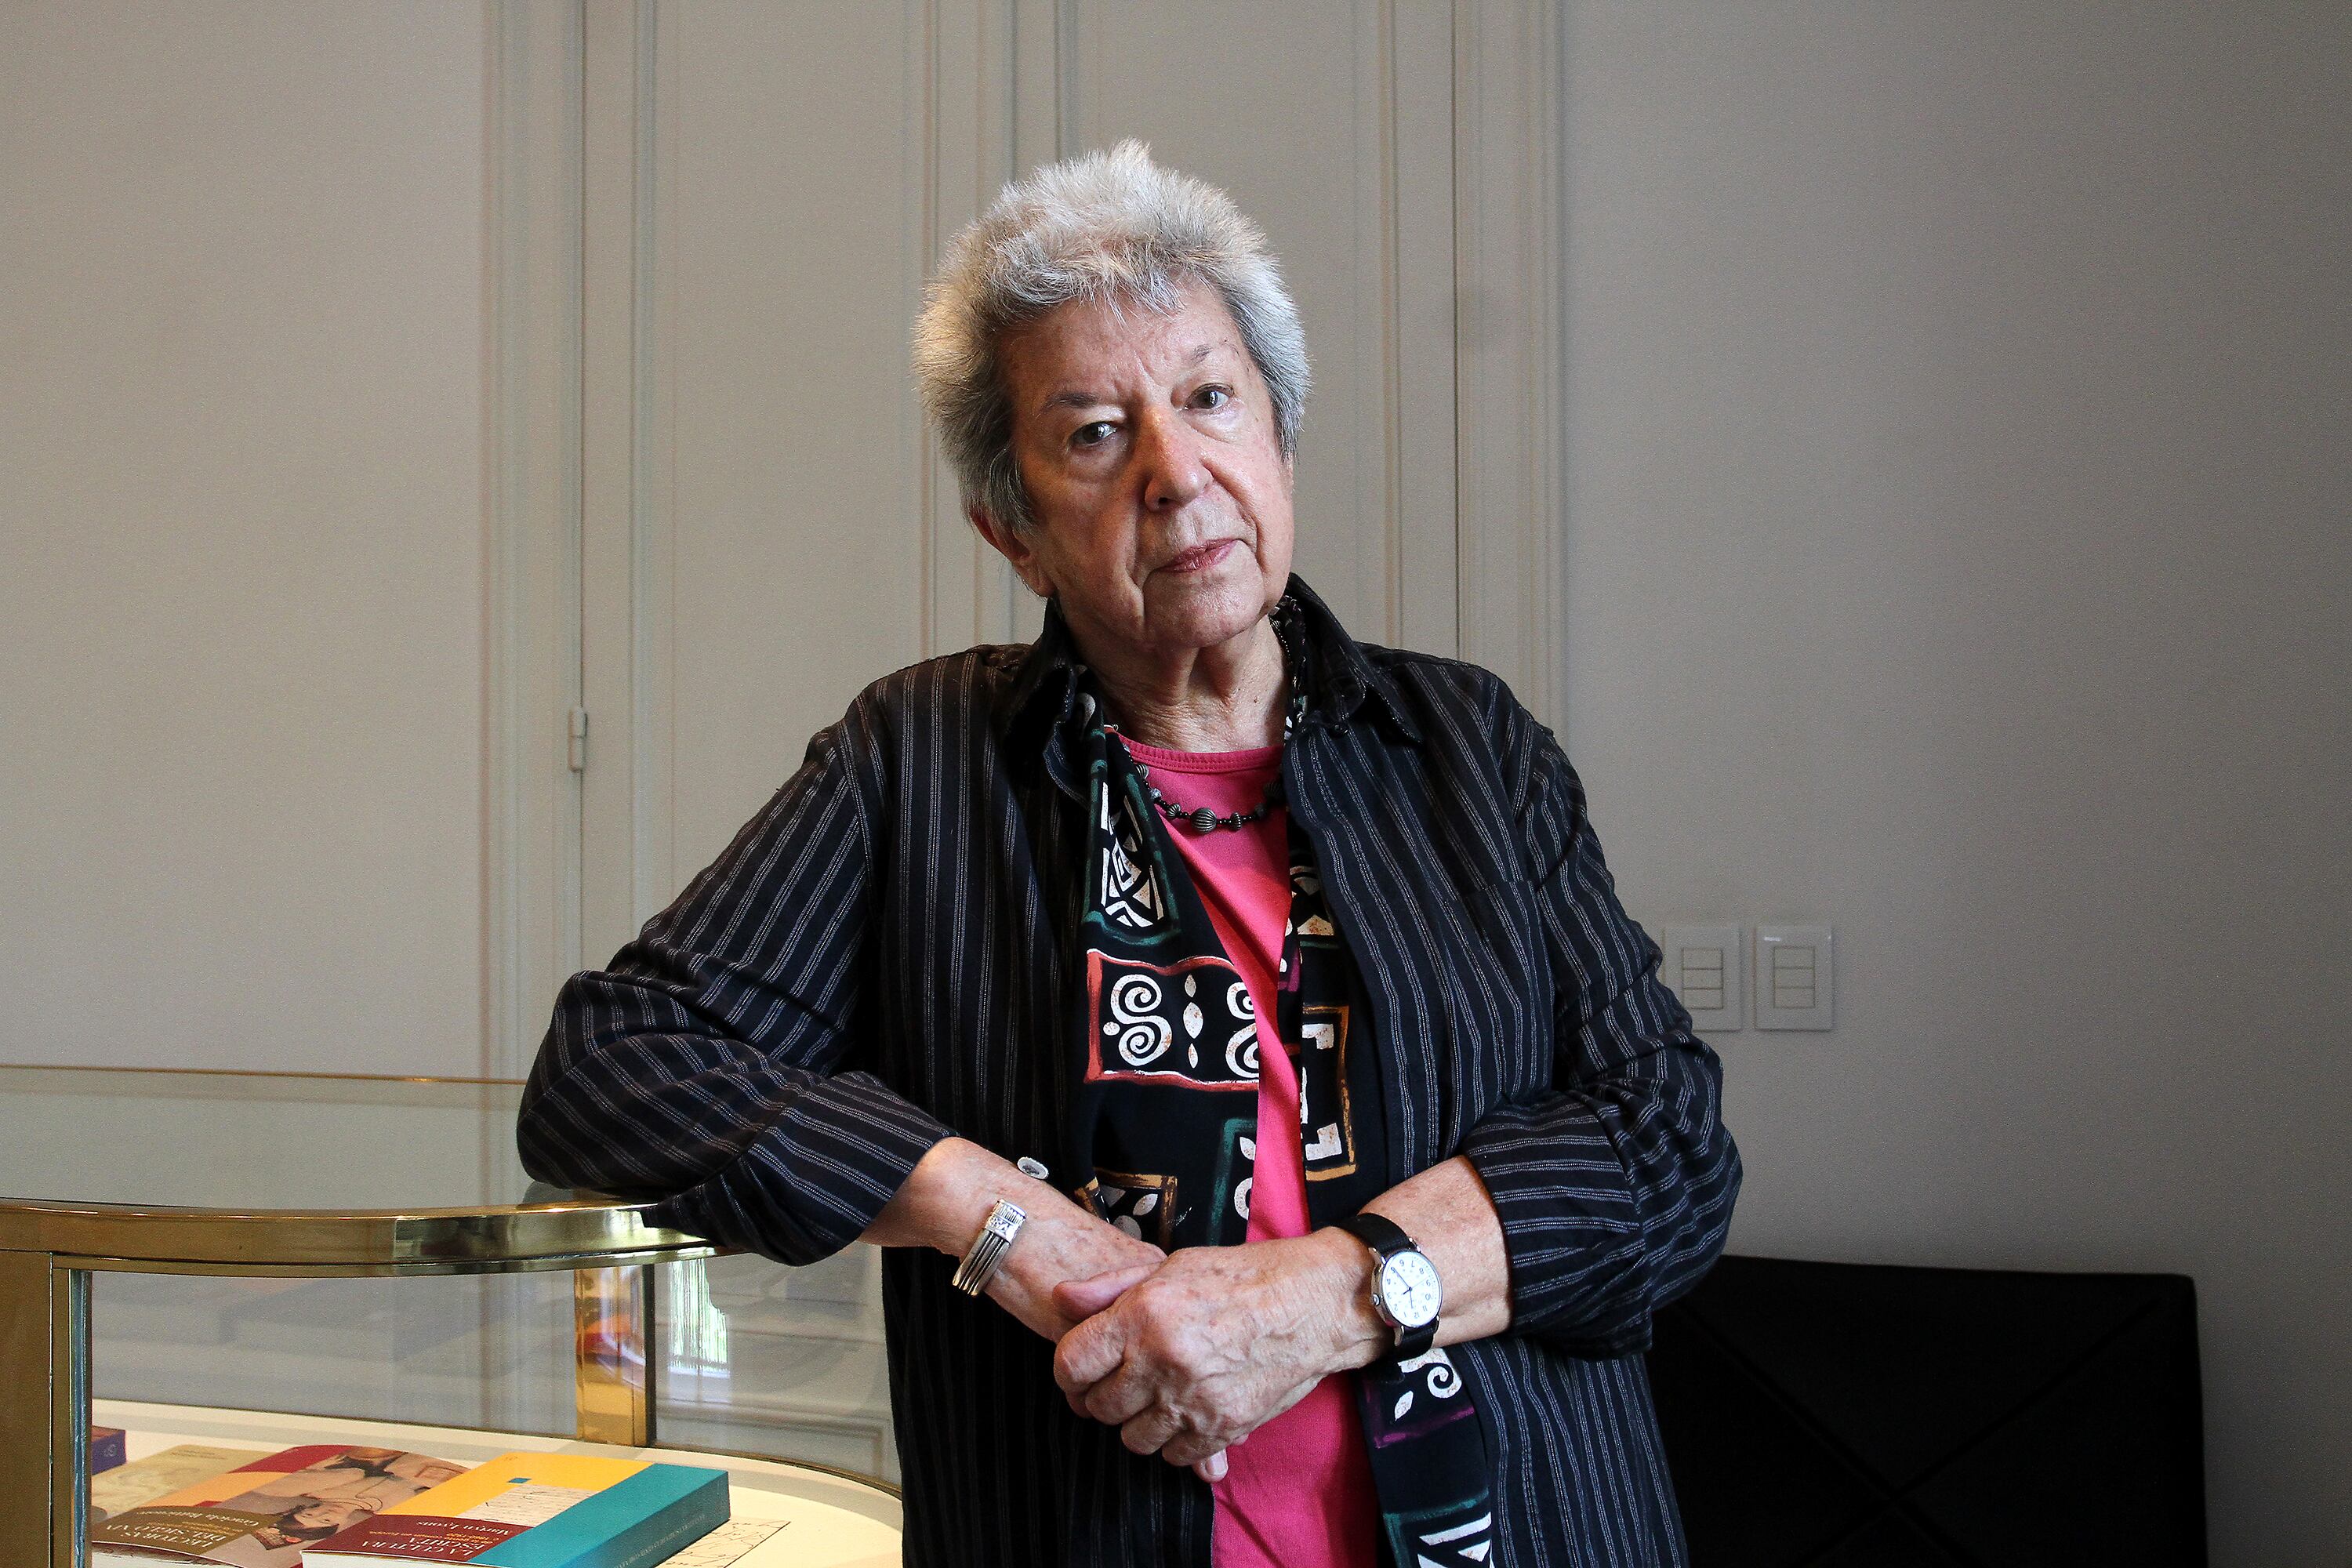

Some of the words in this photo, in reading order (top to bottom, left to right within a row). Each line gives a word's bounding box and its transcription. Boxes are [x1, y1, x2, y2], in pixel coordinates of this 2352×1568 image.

[134, 1526, 190, 1535] SIGLO
[192, 1530, 227, 1542] DEL
[463, 1525, 511, 1535] Martyn
[120, 1531, 213, 1548] LECTORAS
[409, 1537, 485, 1550] ESCRITA
[361, 1541, 445, 1553] CULTURA
[448, 1548, 474, 1556] LA
